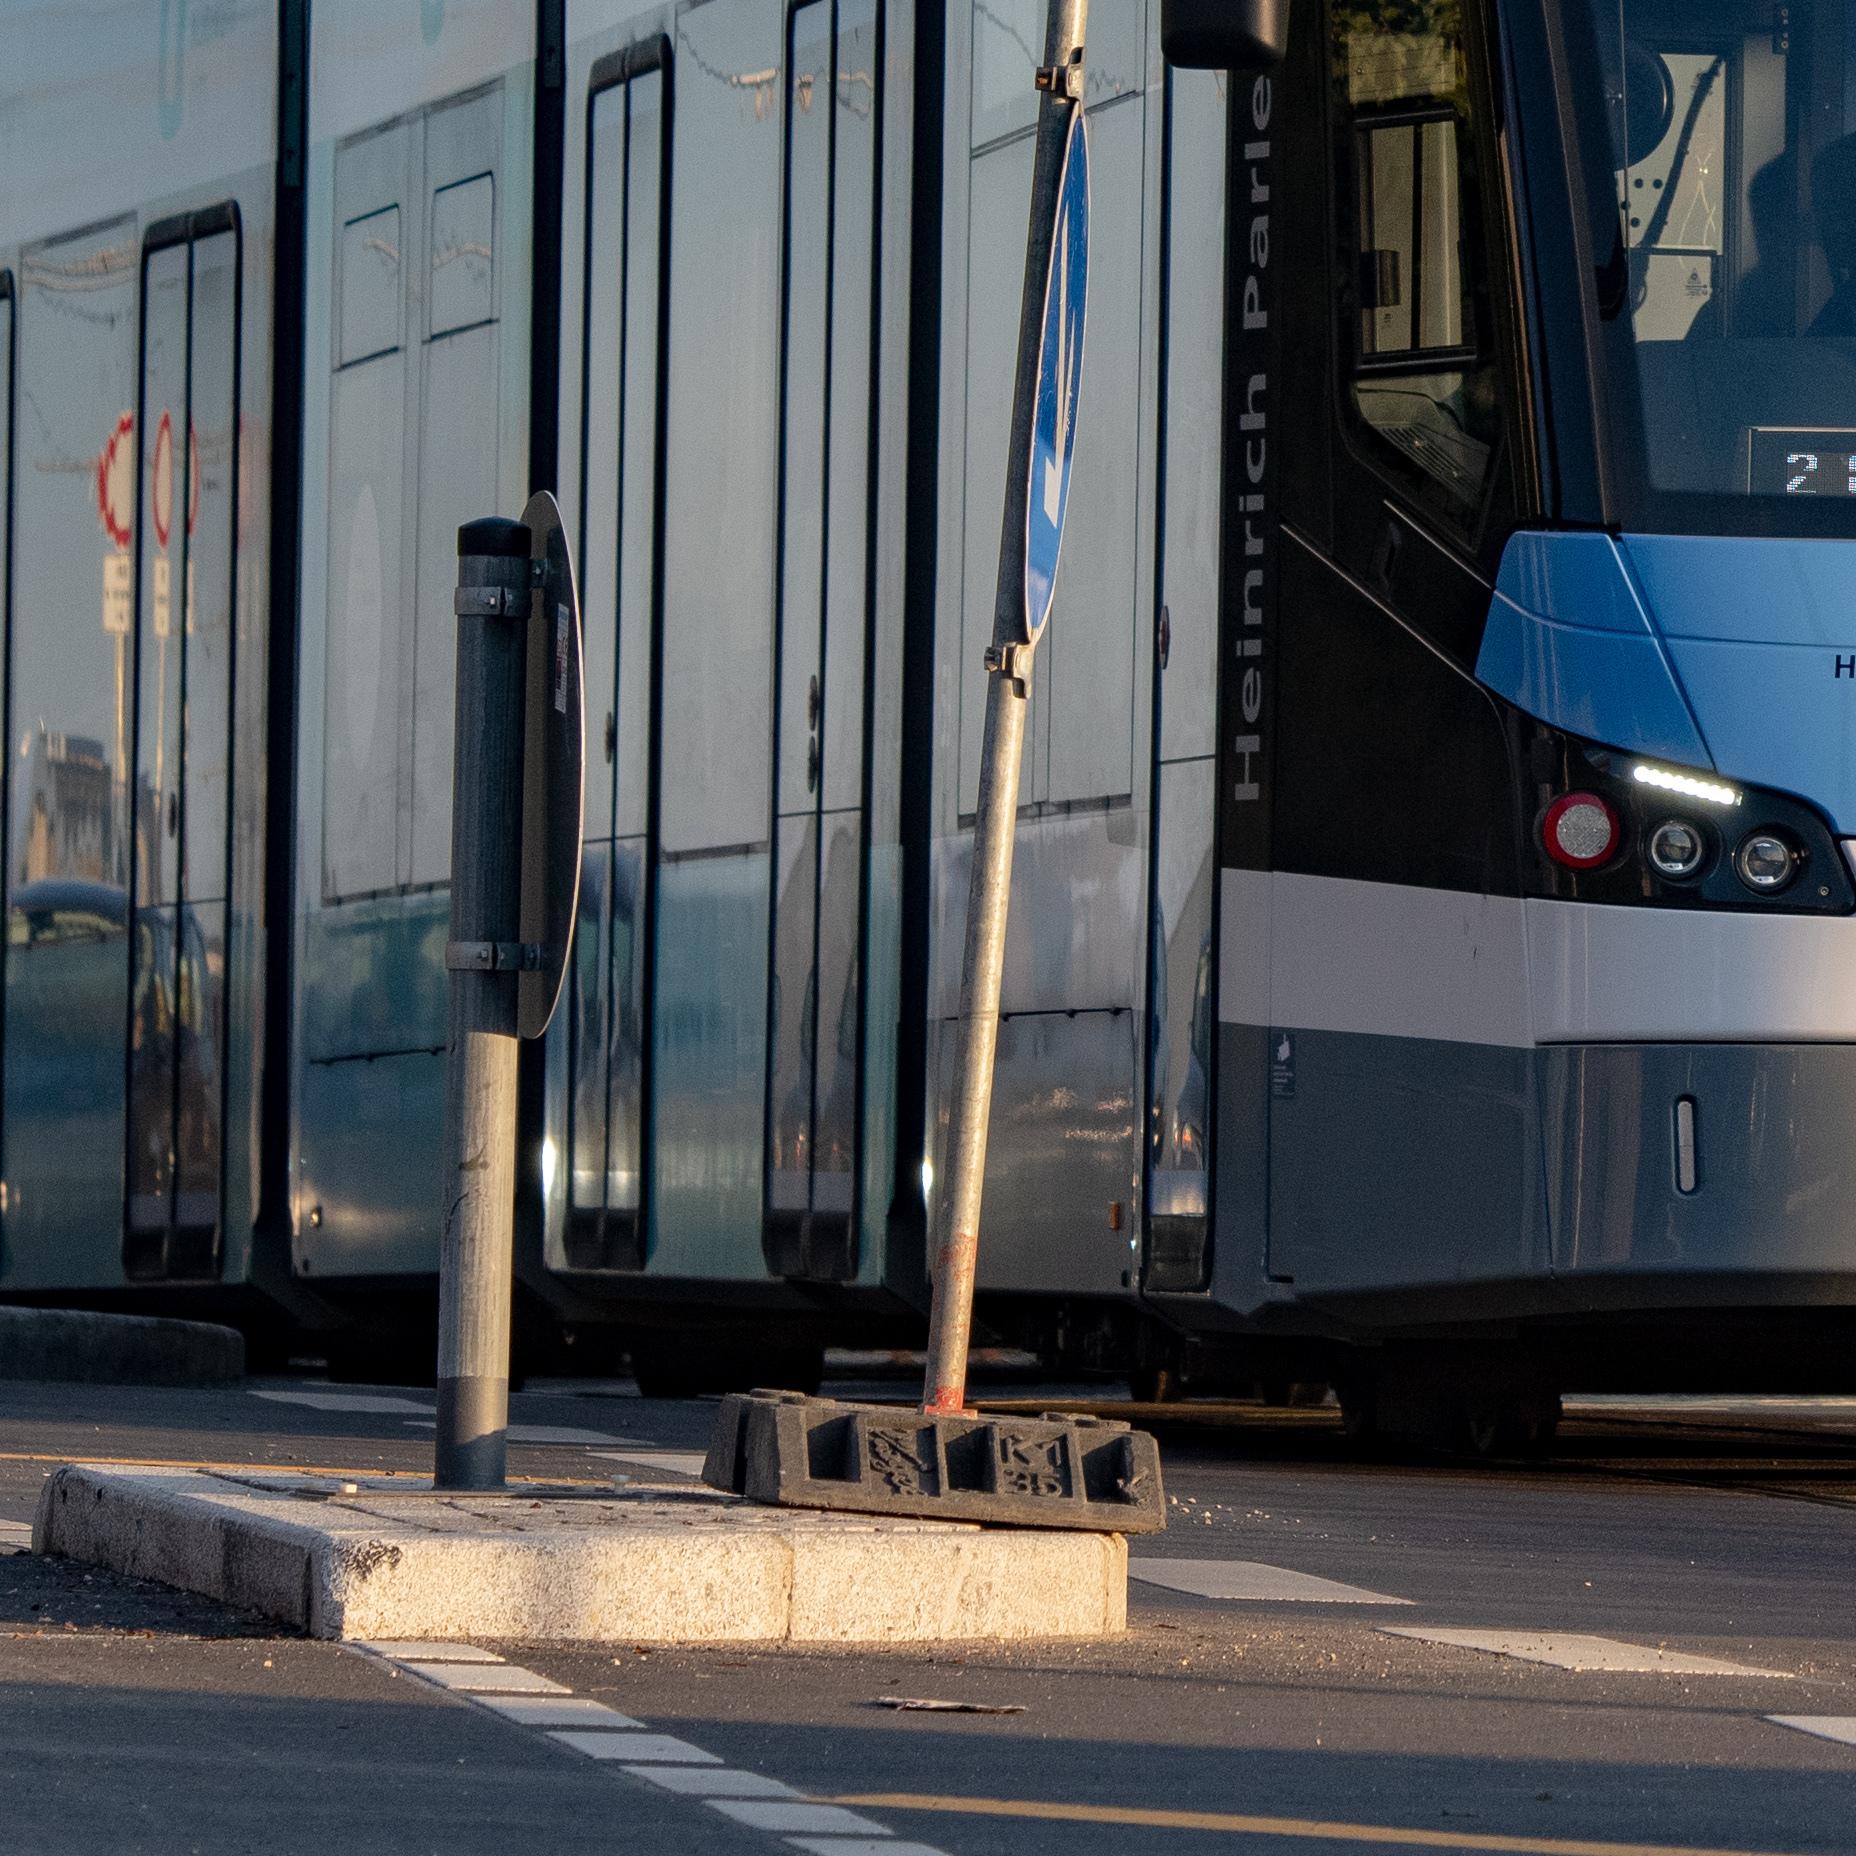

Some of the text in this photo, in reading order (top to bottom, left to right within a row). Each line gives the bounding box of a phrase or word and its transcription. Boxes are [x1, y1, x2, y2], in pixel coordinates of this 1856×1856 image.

[1235, 74, 1272, 801] Heinrich Parle
[1786, 454, 1818, 494] 2
